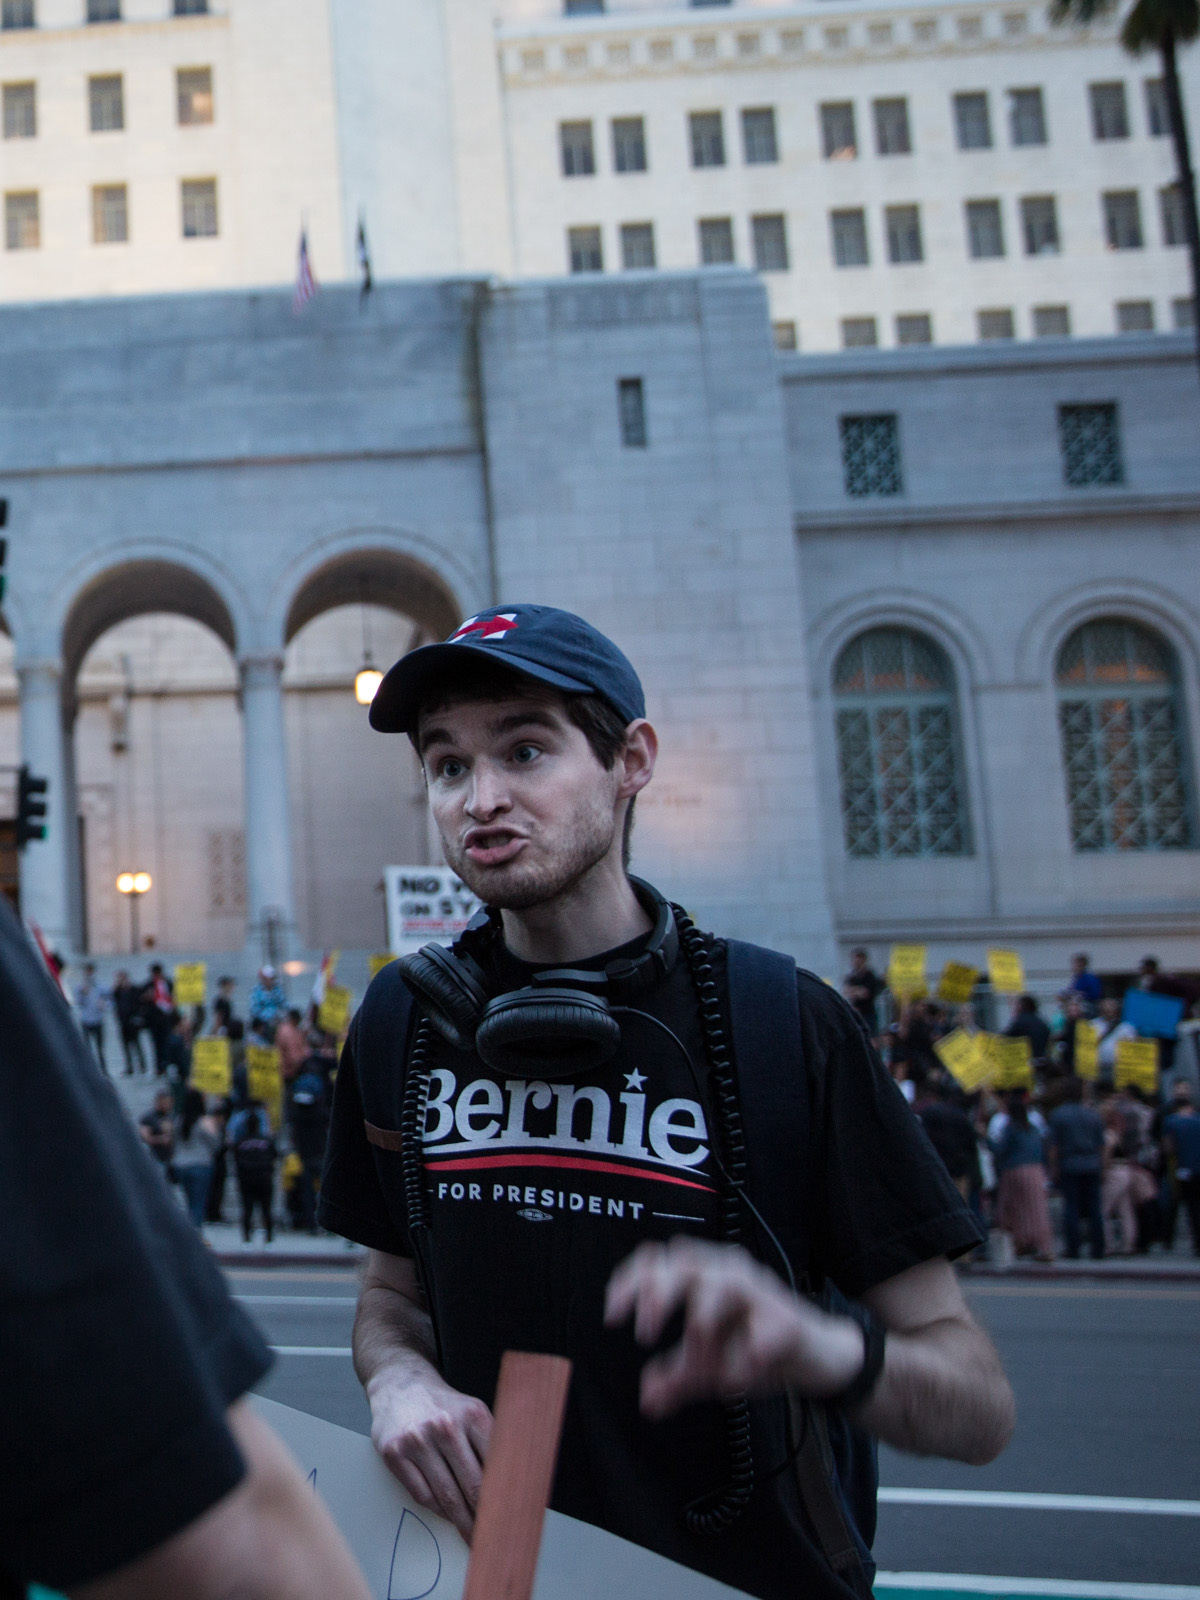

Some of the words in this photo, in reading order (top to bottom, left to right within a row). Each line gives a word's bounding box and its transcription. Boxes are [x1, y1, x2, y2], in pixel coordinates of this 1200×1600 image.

[418, 1067, 710, 1167] Bernie
[438, 1182, 482, 1200] FOR
[492, 1184, 645, 1220] PRESIDENT
